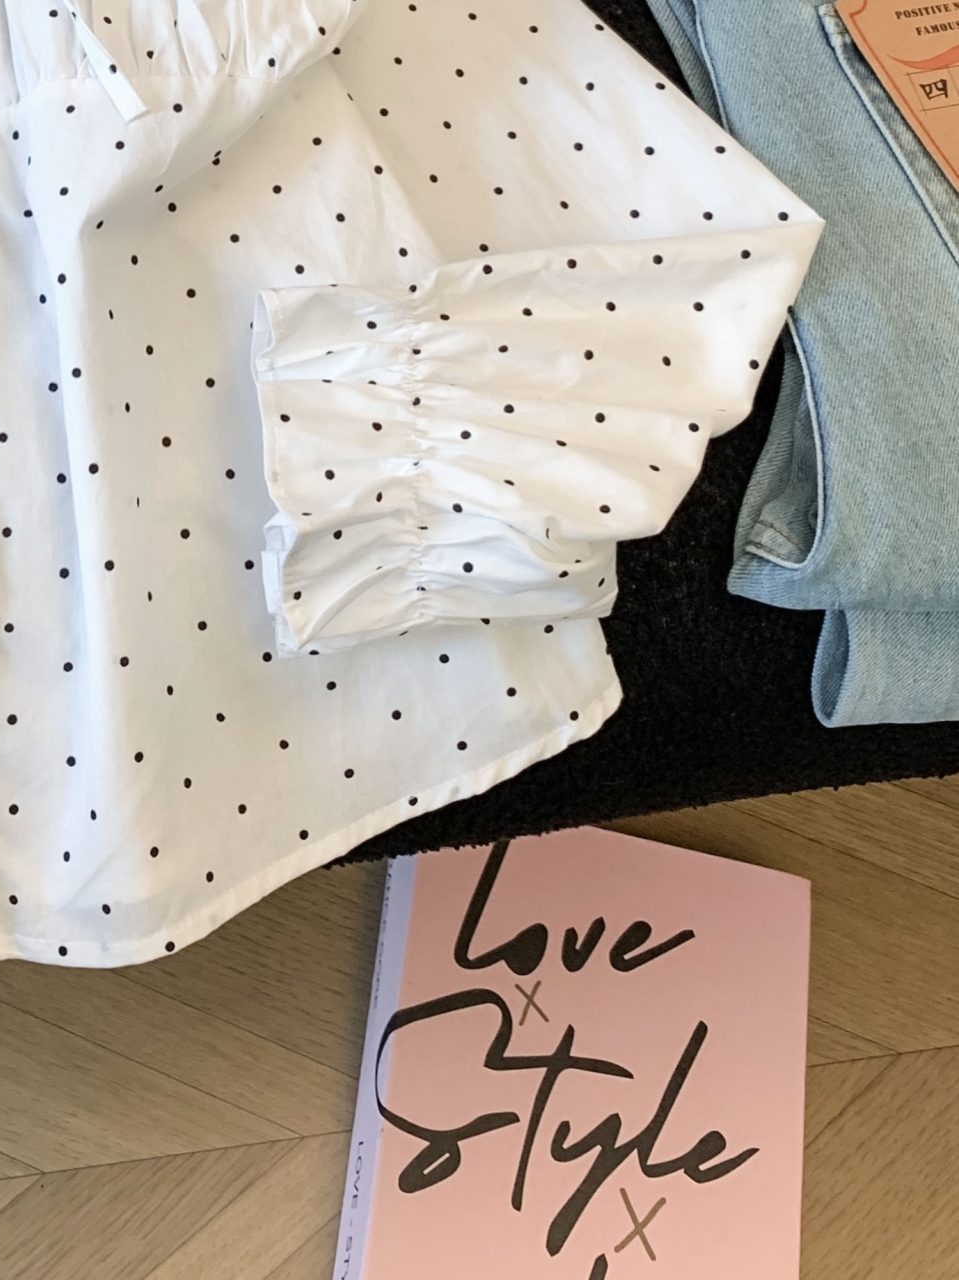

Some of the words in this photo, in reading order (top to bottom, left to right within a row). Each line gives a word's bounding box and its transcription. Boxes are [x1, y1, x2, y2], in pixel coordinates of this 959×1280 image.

[894, 2, 952, 20] POSITIVE
[915, 21, 959, 36] FAMOUS
[453, 839, 696, 976] Love
[374, 987, 761, 1258] Style
